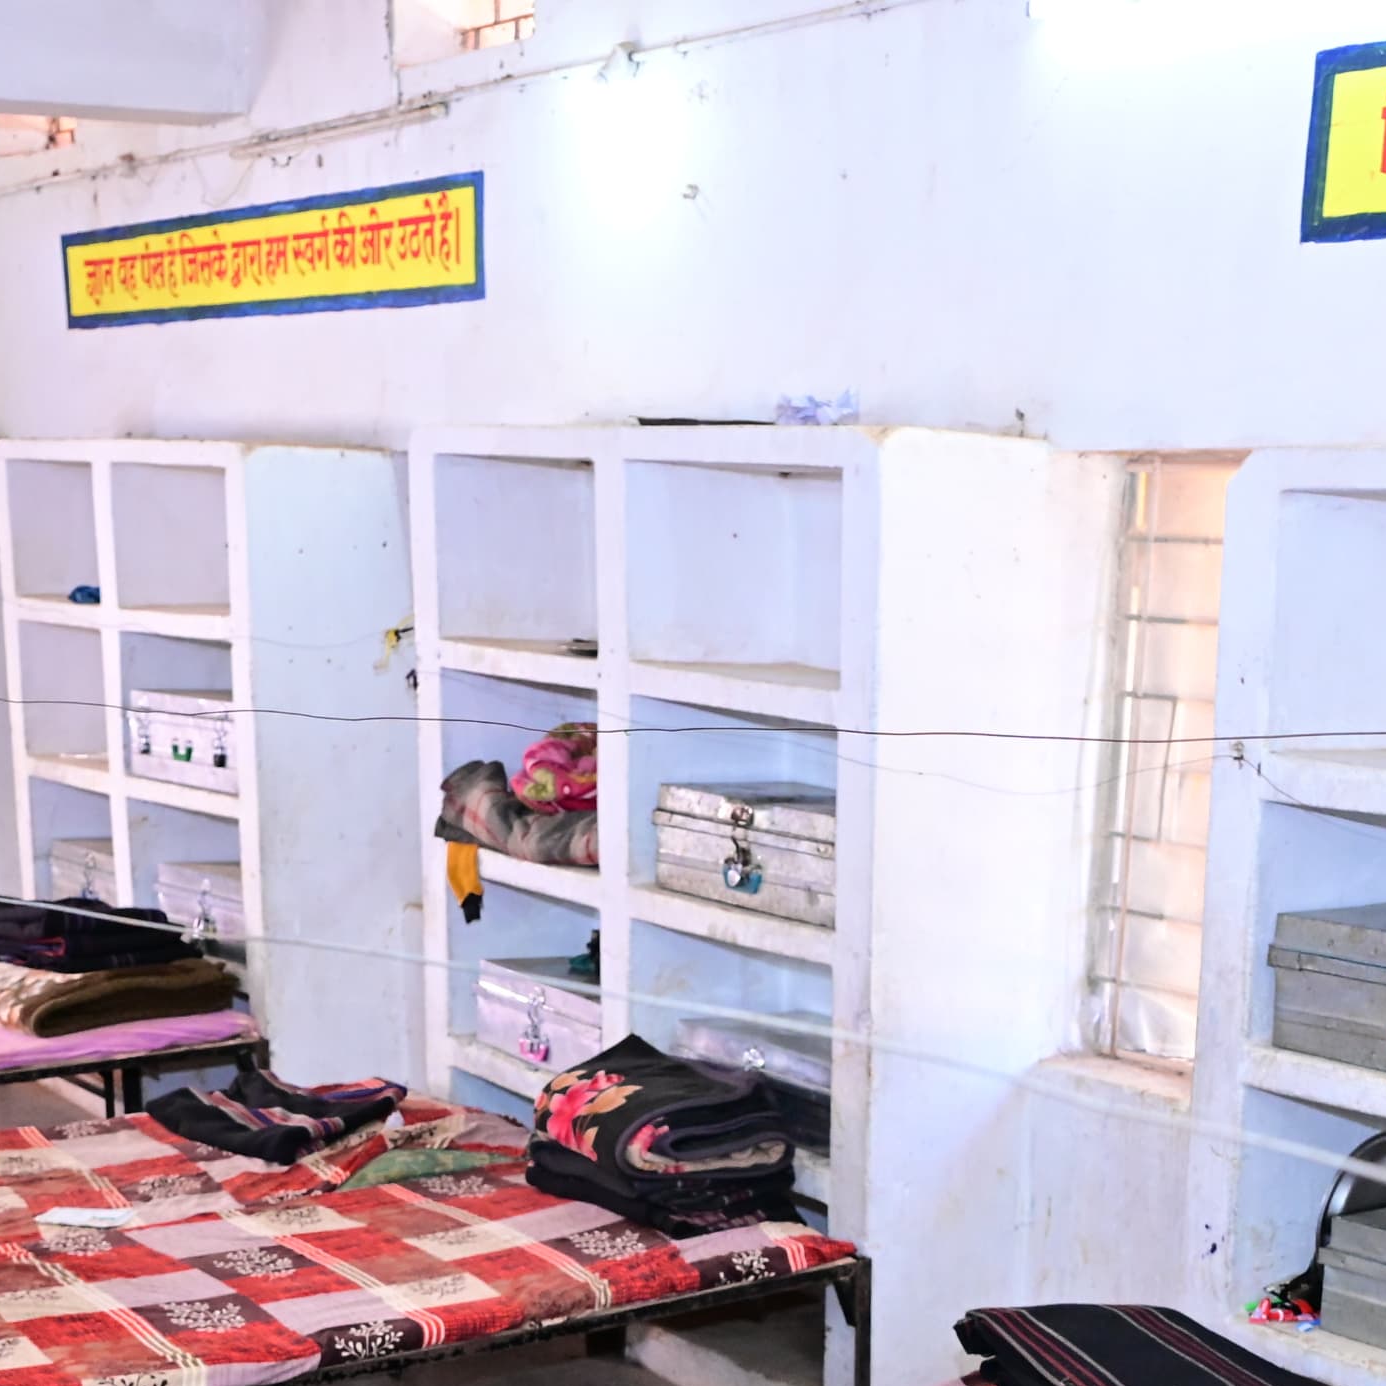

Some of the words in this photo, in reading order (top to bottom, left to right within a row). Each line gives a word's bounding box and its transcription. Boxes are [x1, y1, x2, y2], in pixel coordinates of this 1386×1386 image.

[179, 229, 227, 288] जिसके
[230, 238, 263, 288] द्वारा
[264, 235, 289, 285] हम
[292, 214, 330, 277] स्वर्ग
[332, 210, 357, 270] की
[359, 206, 397, 271] ओर
[398, 198, 436, 265] उठते
